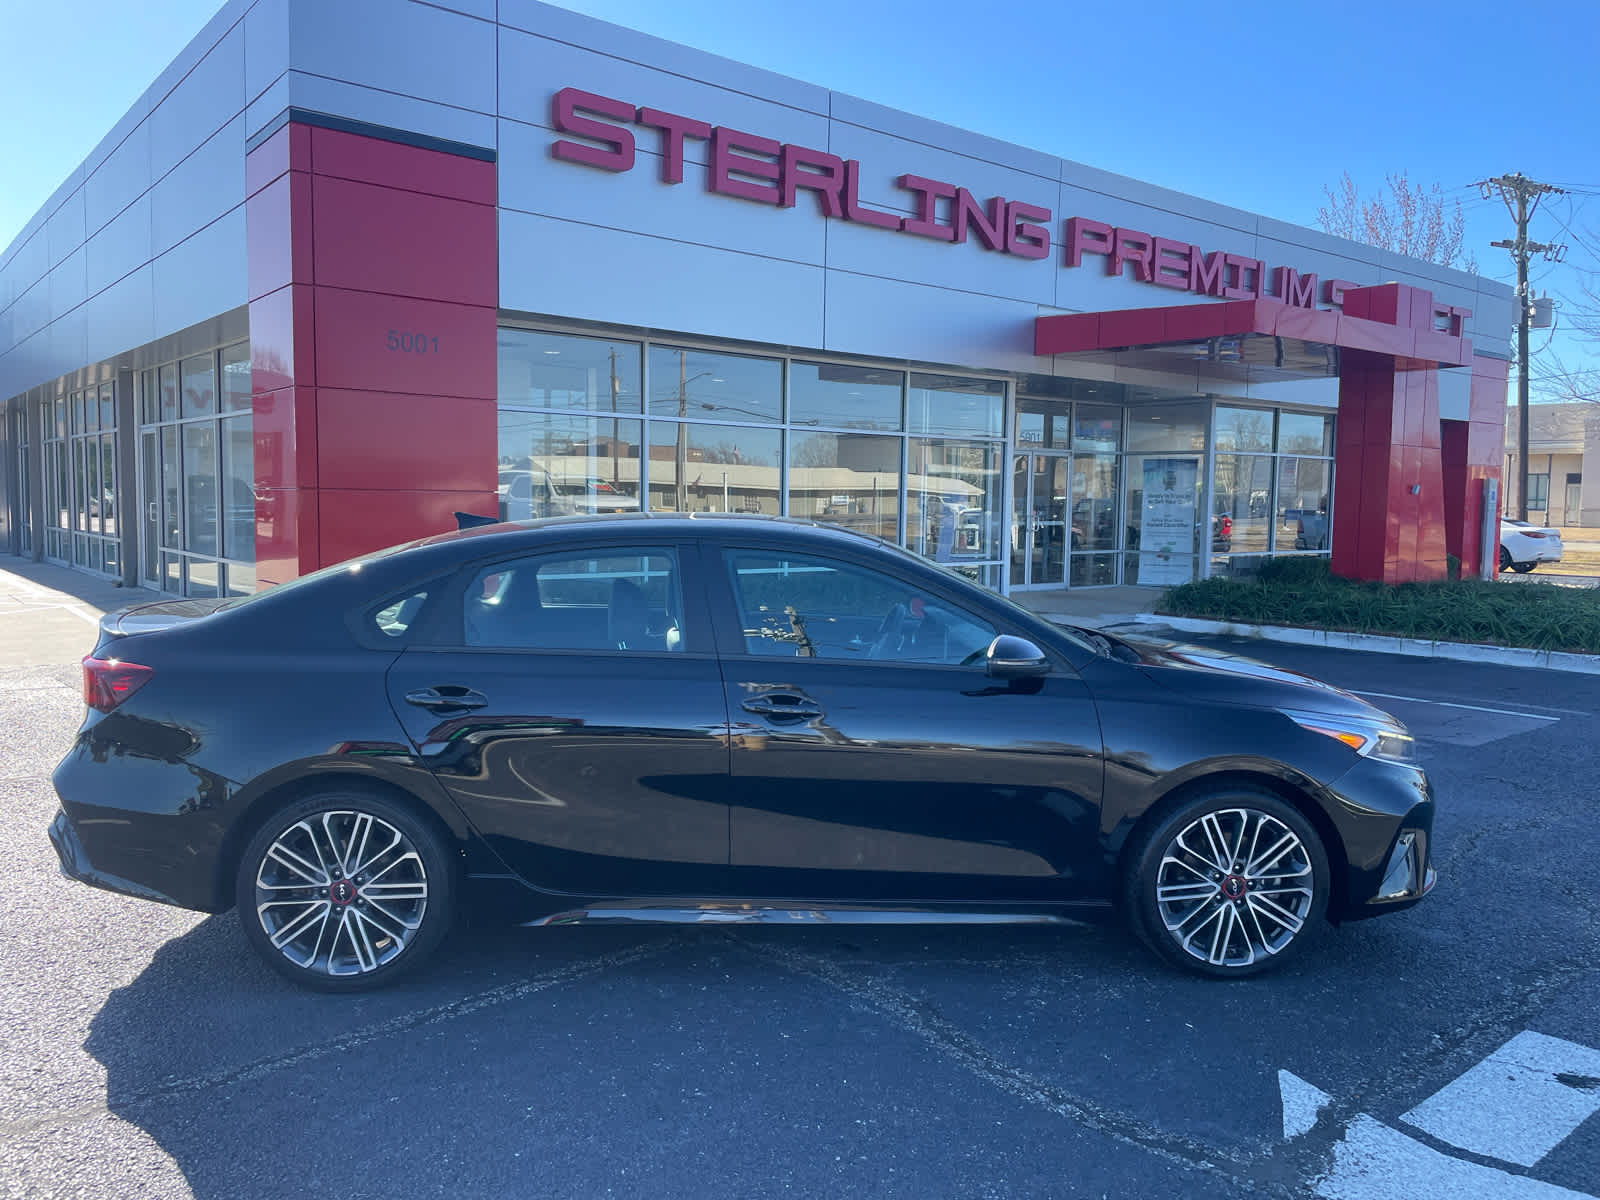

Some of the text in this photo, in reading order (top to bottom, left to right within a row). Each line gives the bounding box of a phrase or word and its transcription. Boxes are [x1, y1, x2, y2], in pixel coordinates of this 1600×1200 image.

[551, 87, 1052, 260] STERLING
[1064, 216, 1319, 309] PREMIUM
[386, 329, 439, 355] 5001
